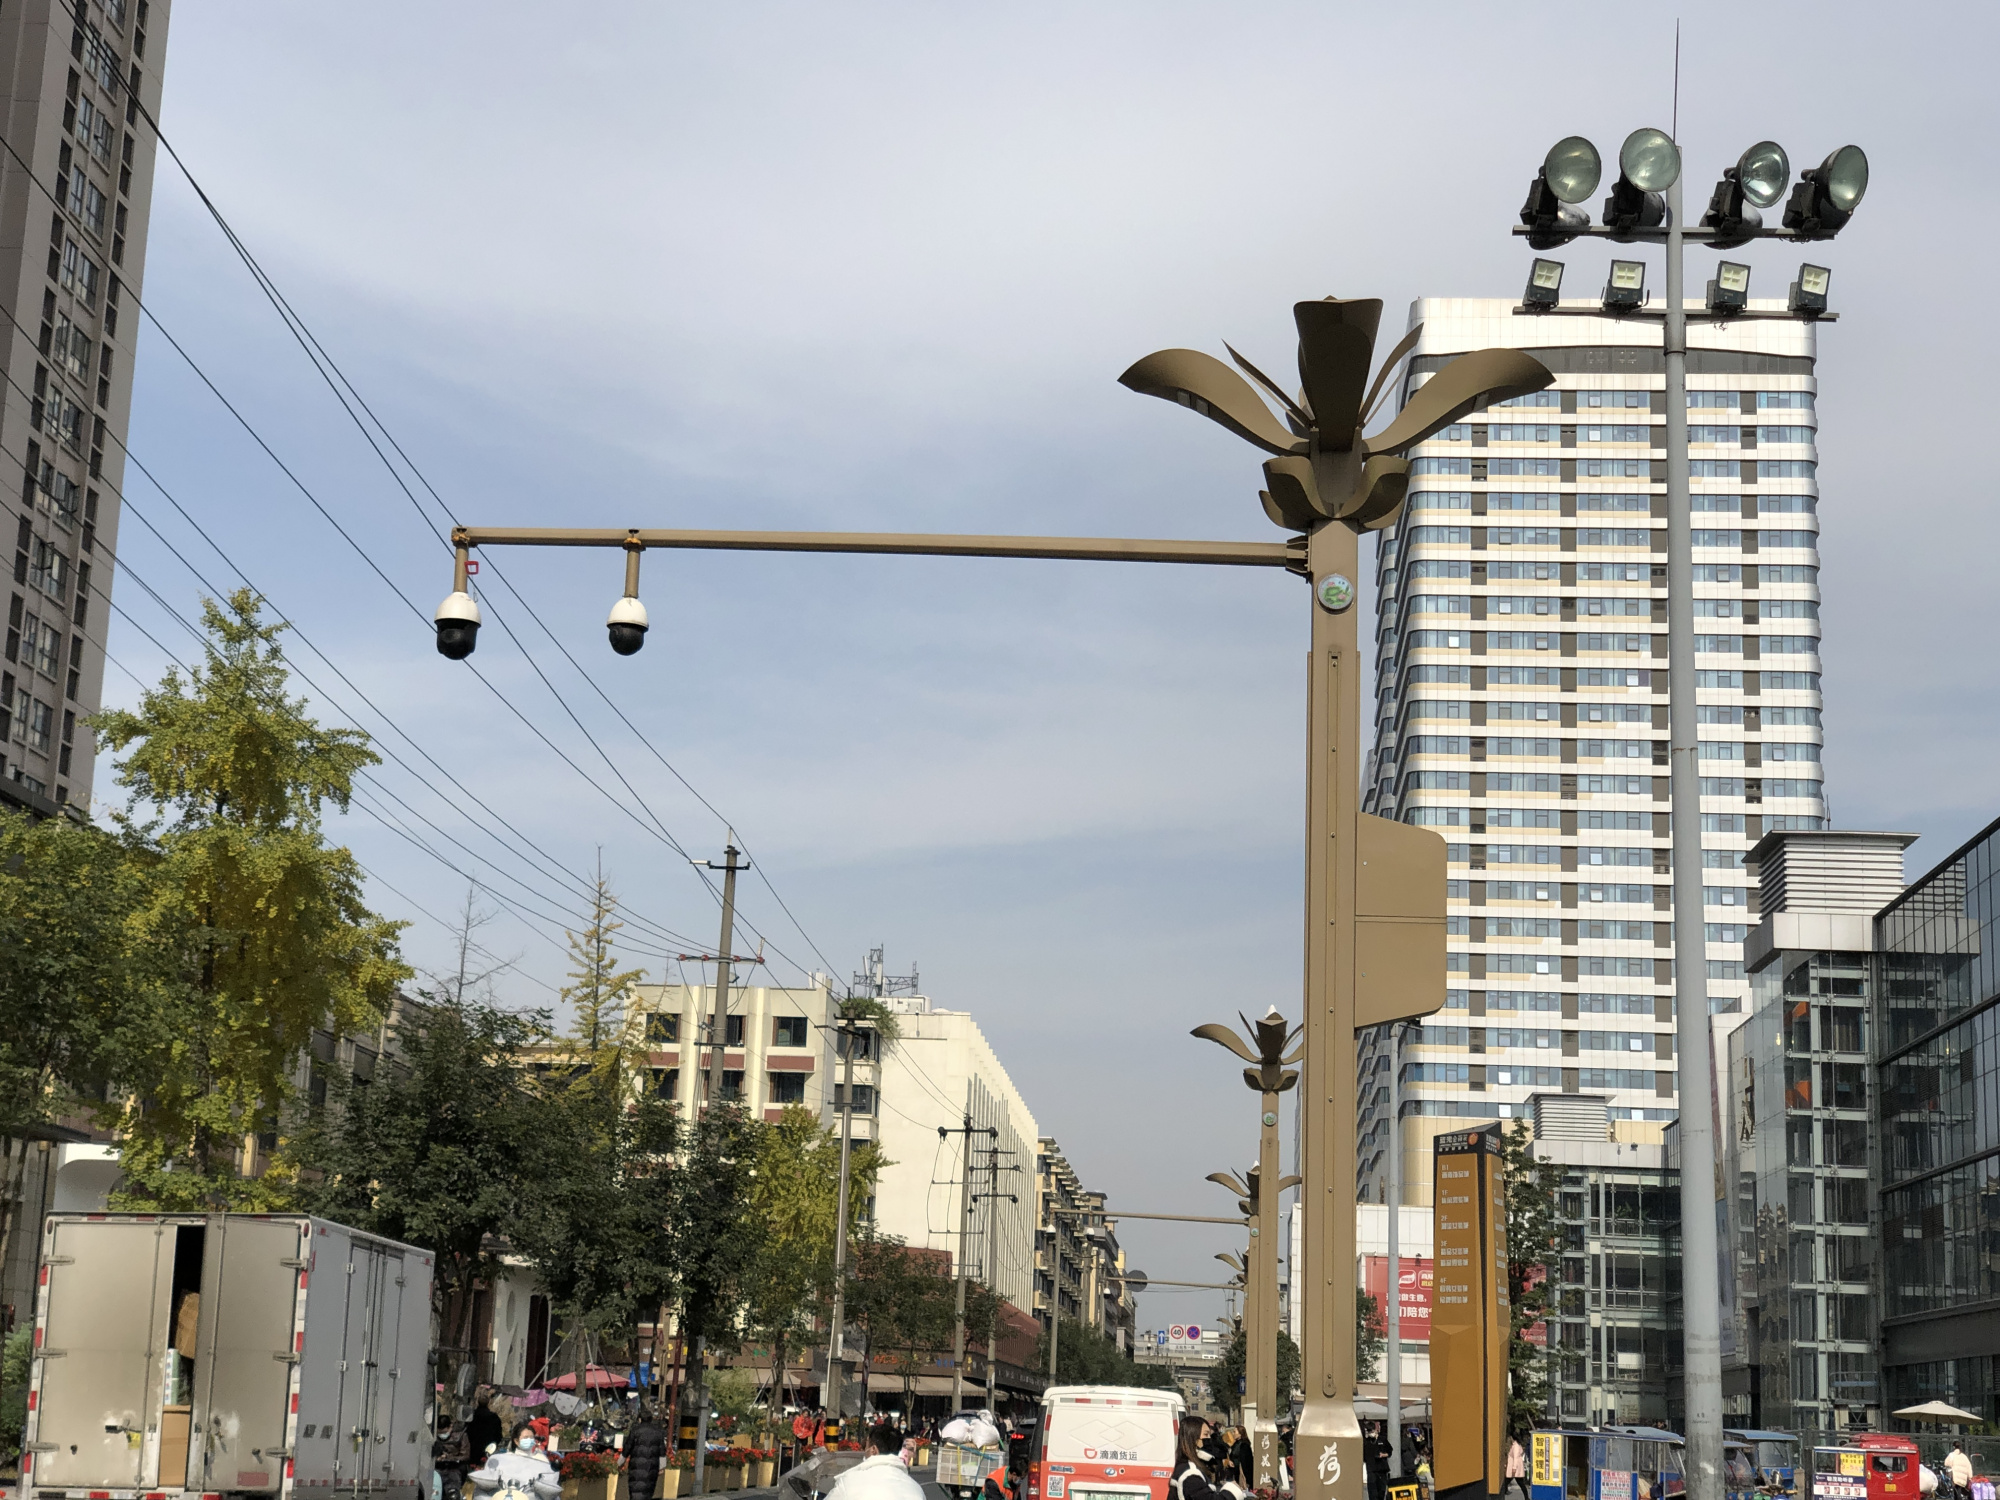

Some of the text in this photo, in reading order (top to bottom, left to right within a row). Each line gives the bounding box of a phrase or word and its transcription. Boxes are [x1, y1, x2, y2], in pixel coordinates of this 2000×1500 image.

[1099, 1450, 1138, 1461] 滴滴货运
[1260, 1434, 1271, 1485] 荷花池
[1536, 1437, 1544, 1480] 智骑锂电
